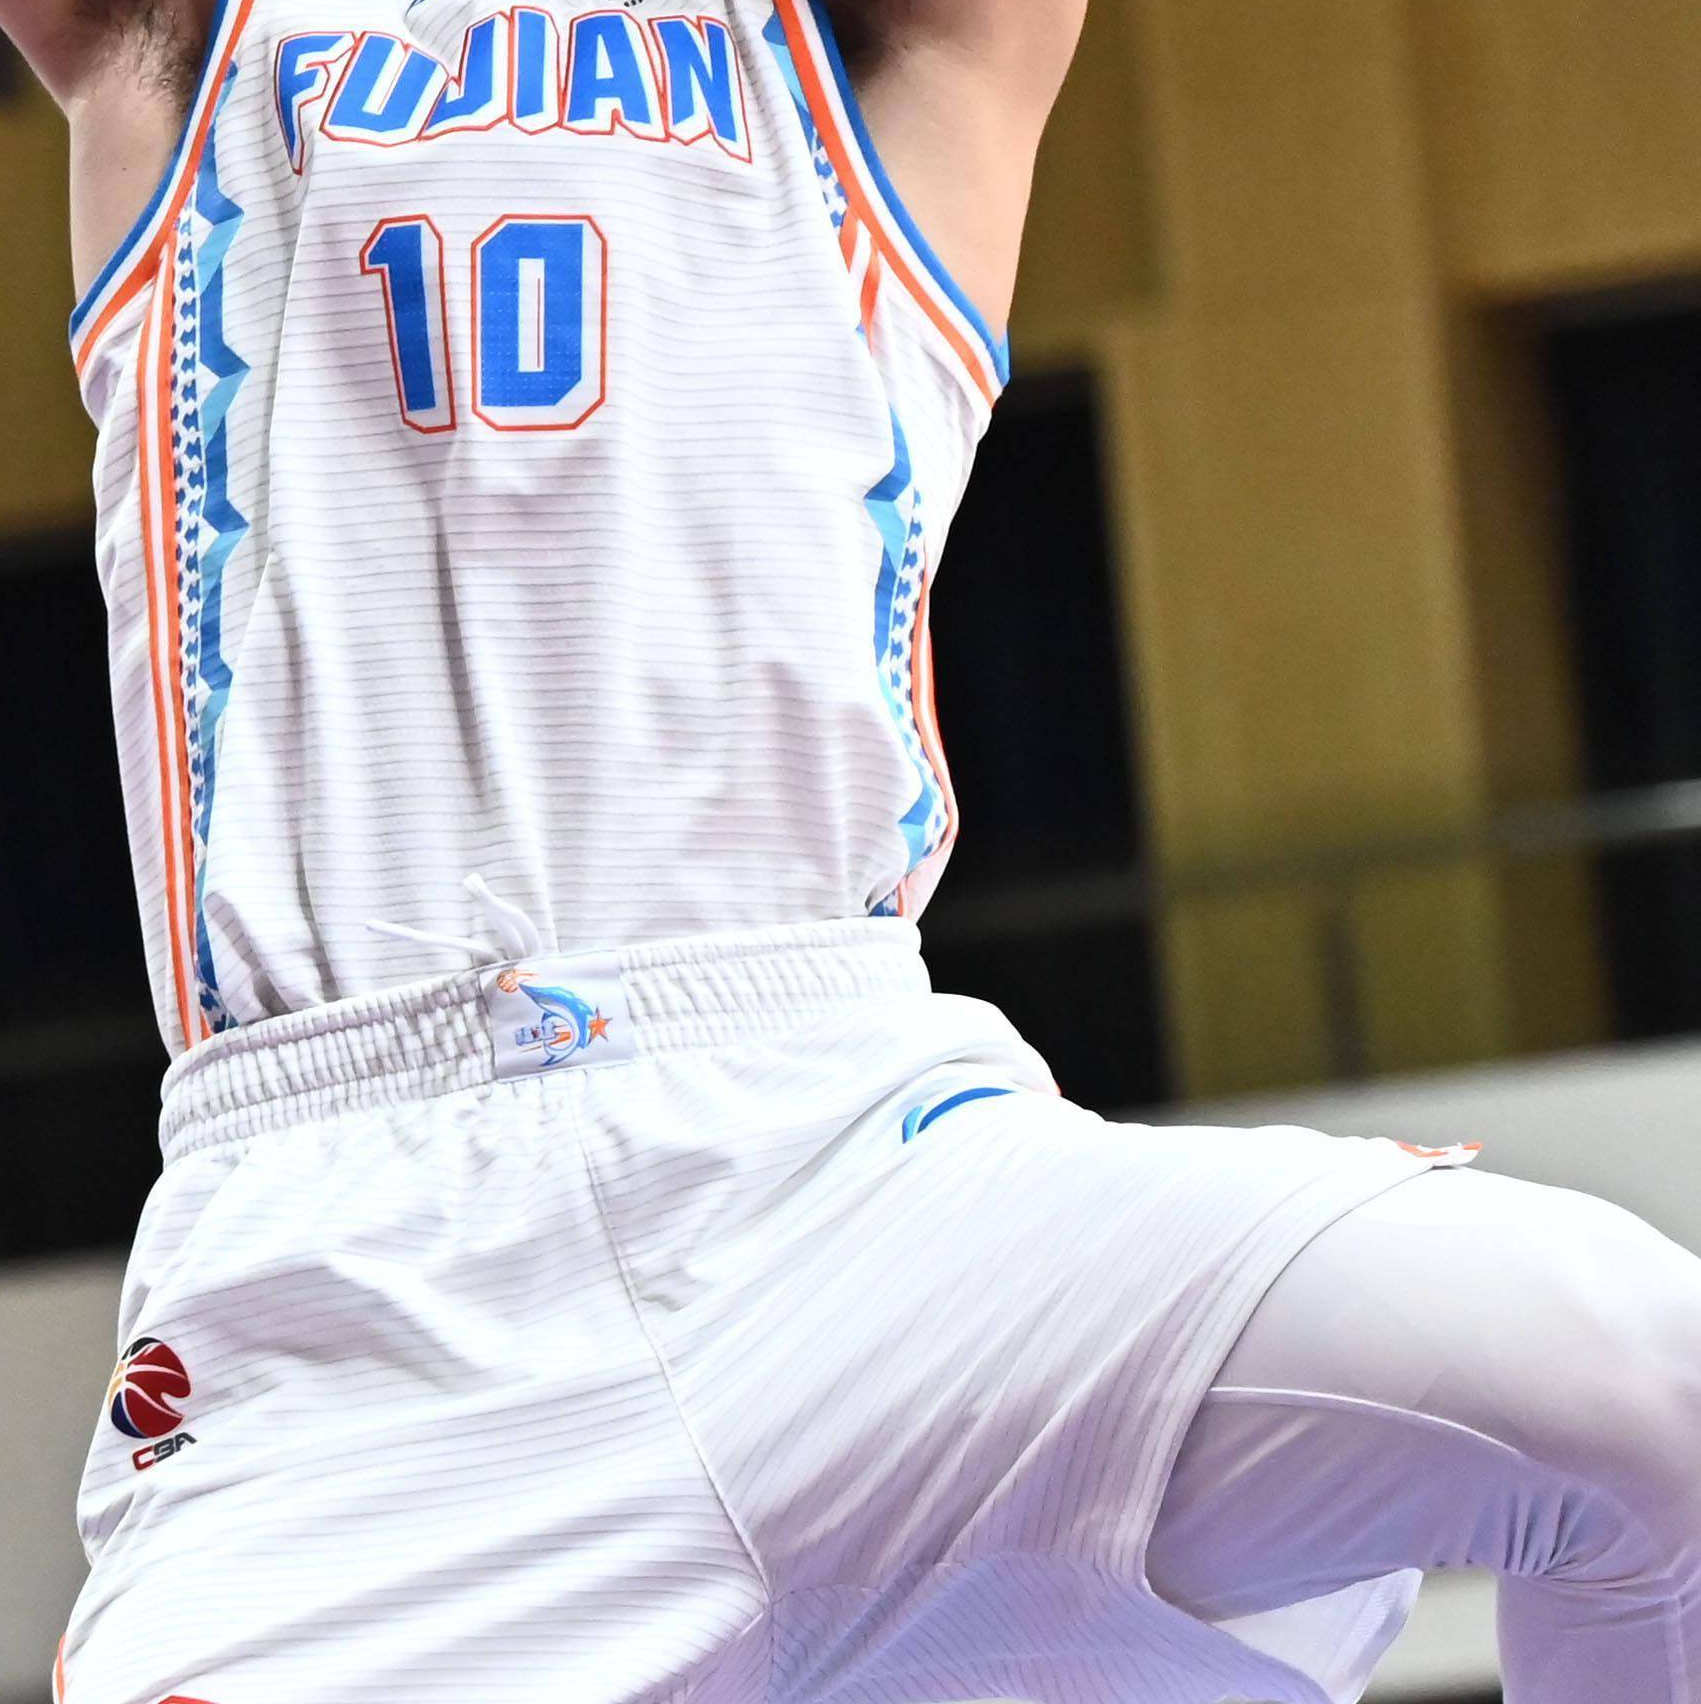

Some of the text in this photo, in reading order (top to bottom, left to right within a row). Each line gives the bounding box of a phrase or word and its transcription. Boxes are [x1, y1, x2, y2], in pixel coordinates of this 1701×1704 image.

[274, 5, 753, 176] FUJIAN
[359, 213, 608, 434] 10
[132, 1431, 198, 1471] CBA
